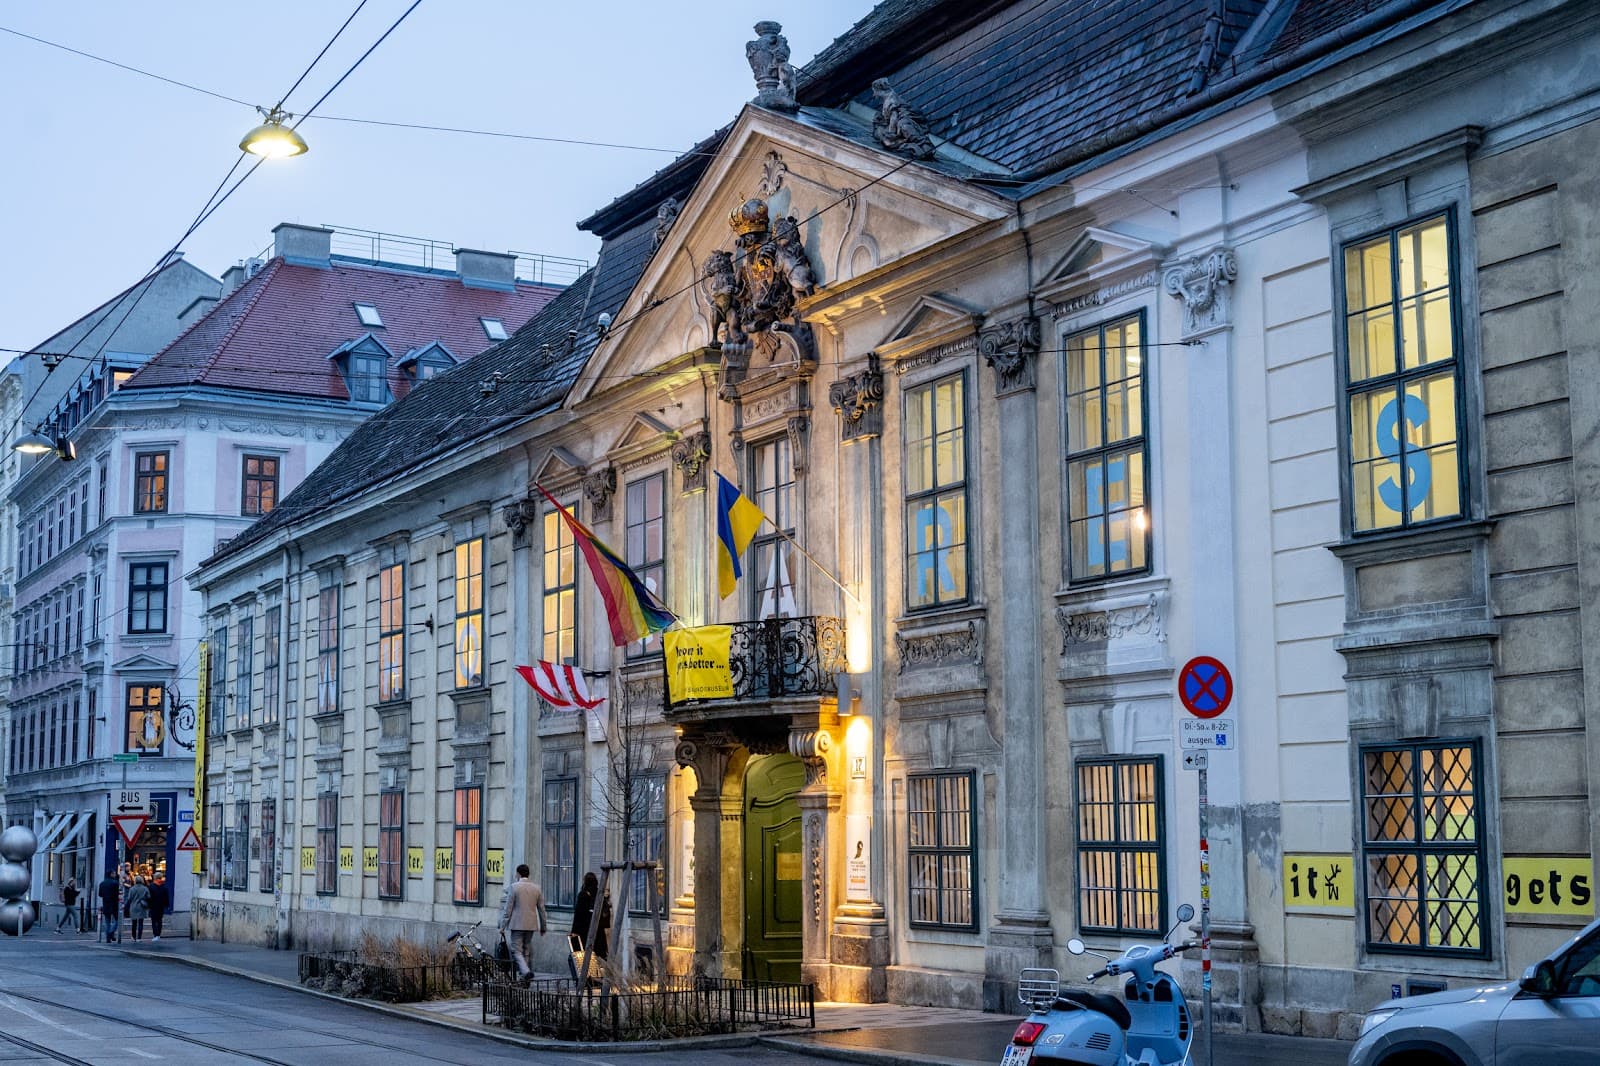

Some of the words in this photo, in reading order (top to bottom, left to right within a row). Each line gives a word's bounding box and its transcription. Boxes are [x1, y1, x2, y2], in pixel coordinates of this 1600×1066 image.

[1376, 394, 1432, 514] S
[120, 791, 141, 803] BUS
[1506, 870, 1591, 906] gets
